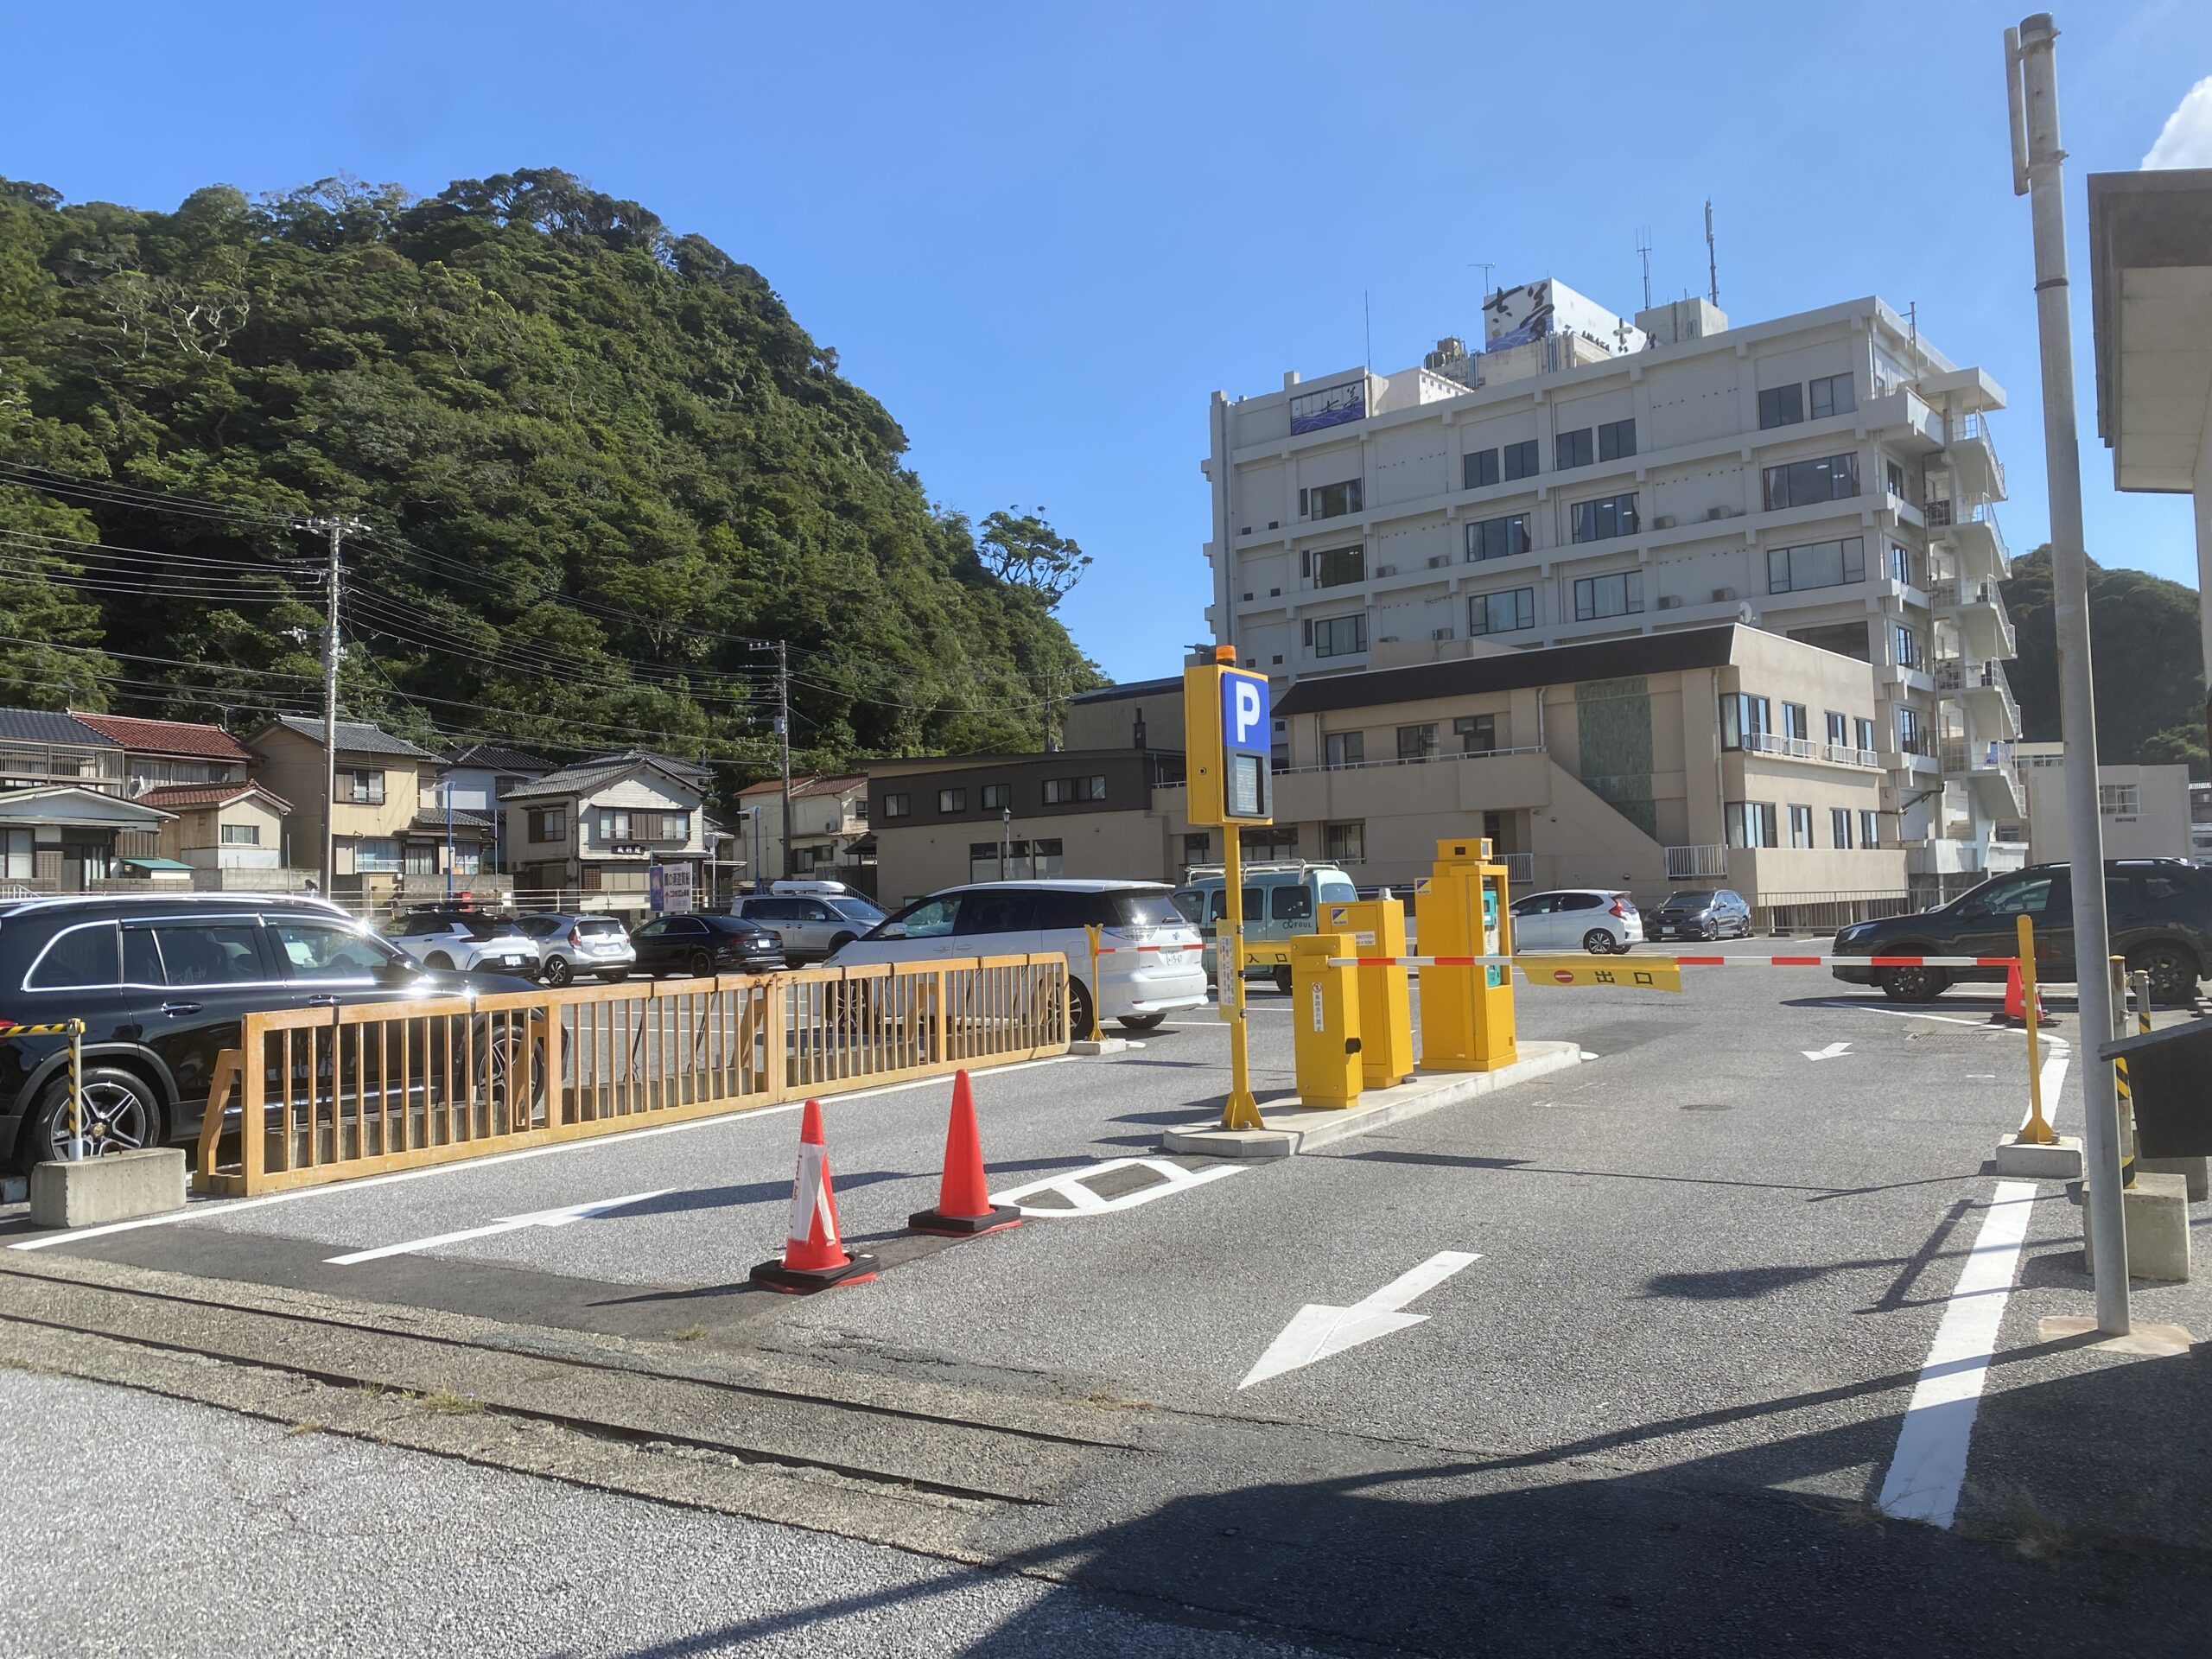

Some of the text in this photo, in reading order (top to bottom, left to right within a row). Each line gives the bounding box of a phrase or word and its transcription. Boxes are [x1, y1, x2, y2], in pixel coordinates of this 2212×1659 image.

[1236, 681, 1261, 743] P
[1248, 953, 1288, 963] 入口
[1595, 970, 1653, 985] 出口
